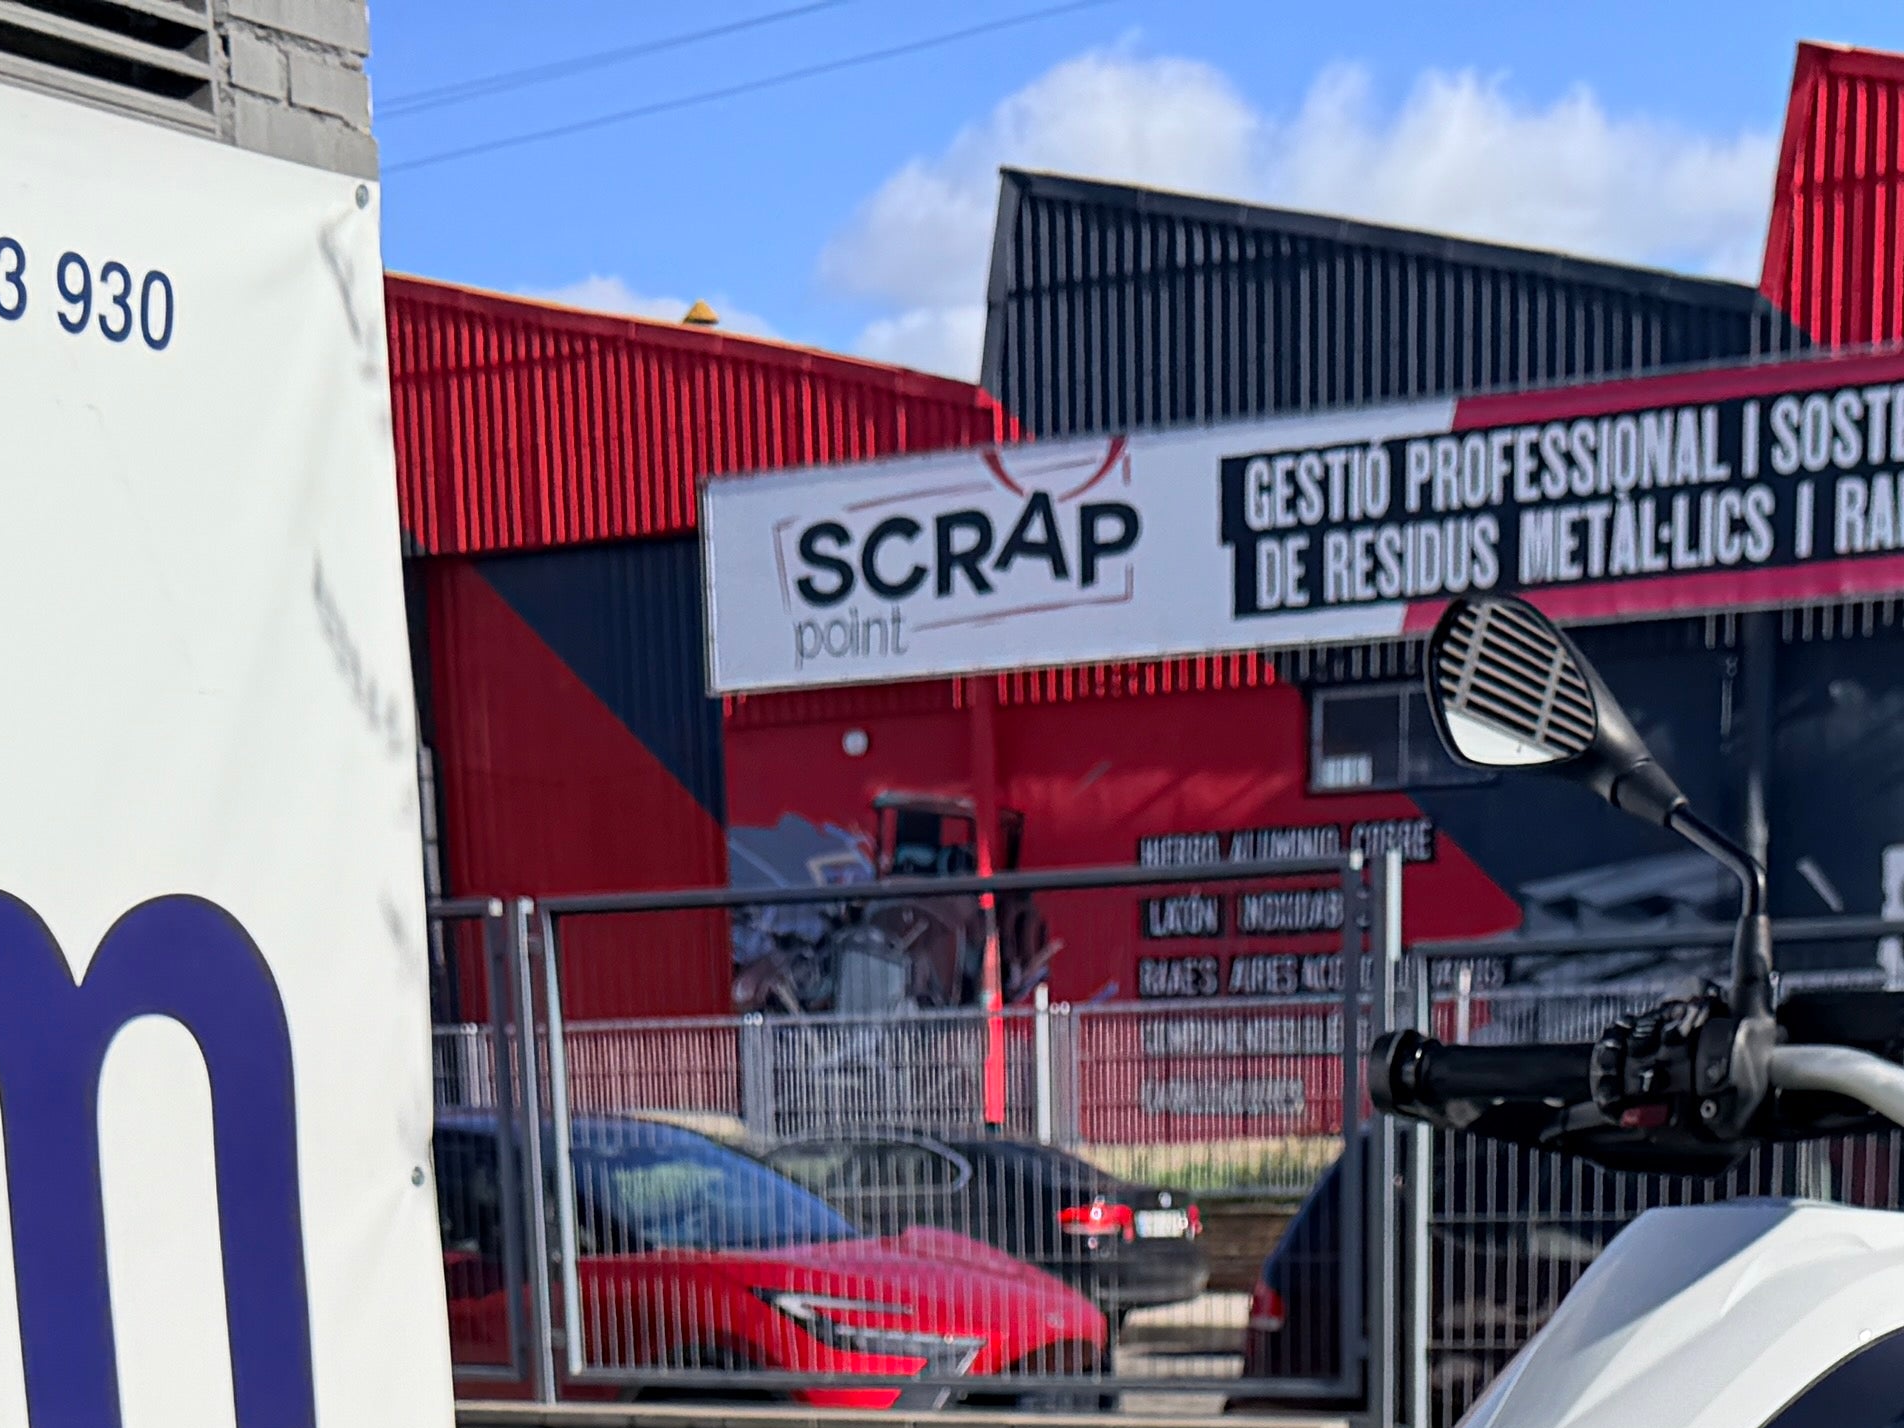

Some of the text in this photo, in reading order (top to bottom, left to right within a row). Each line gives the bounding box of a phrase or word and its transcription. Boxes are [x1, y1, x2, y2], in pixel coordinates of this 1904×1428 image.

[57, 250, 174, 351] 930
[1245, 441, 1391, 532] GESTIÓ
[1405, 404, 1731, 513] PROFESSIONAL
[1741, 399, 1761, 479] I
[796, 491, 1140, 607] SCRAP
[1256, 534, 1310, 610] DE
[1323, 512, 1499, 604] RESIDUS
[1795, 479, 1815, 559] I
[795, 606, 908, 670] point
